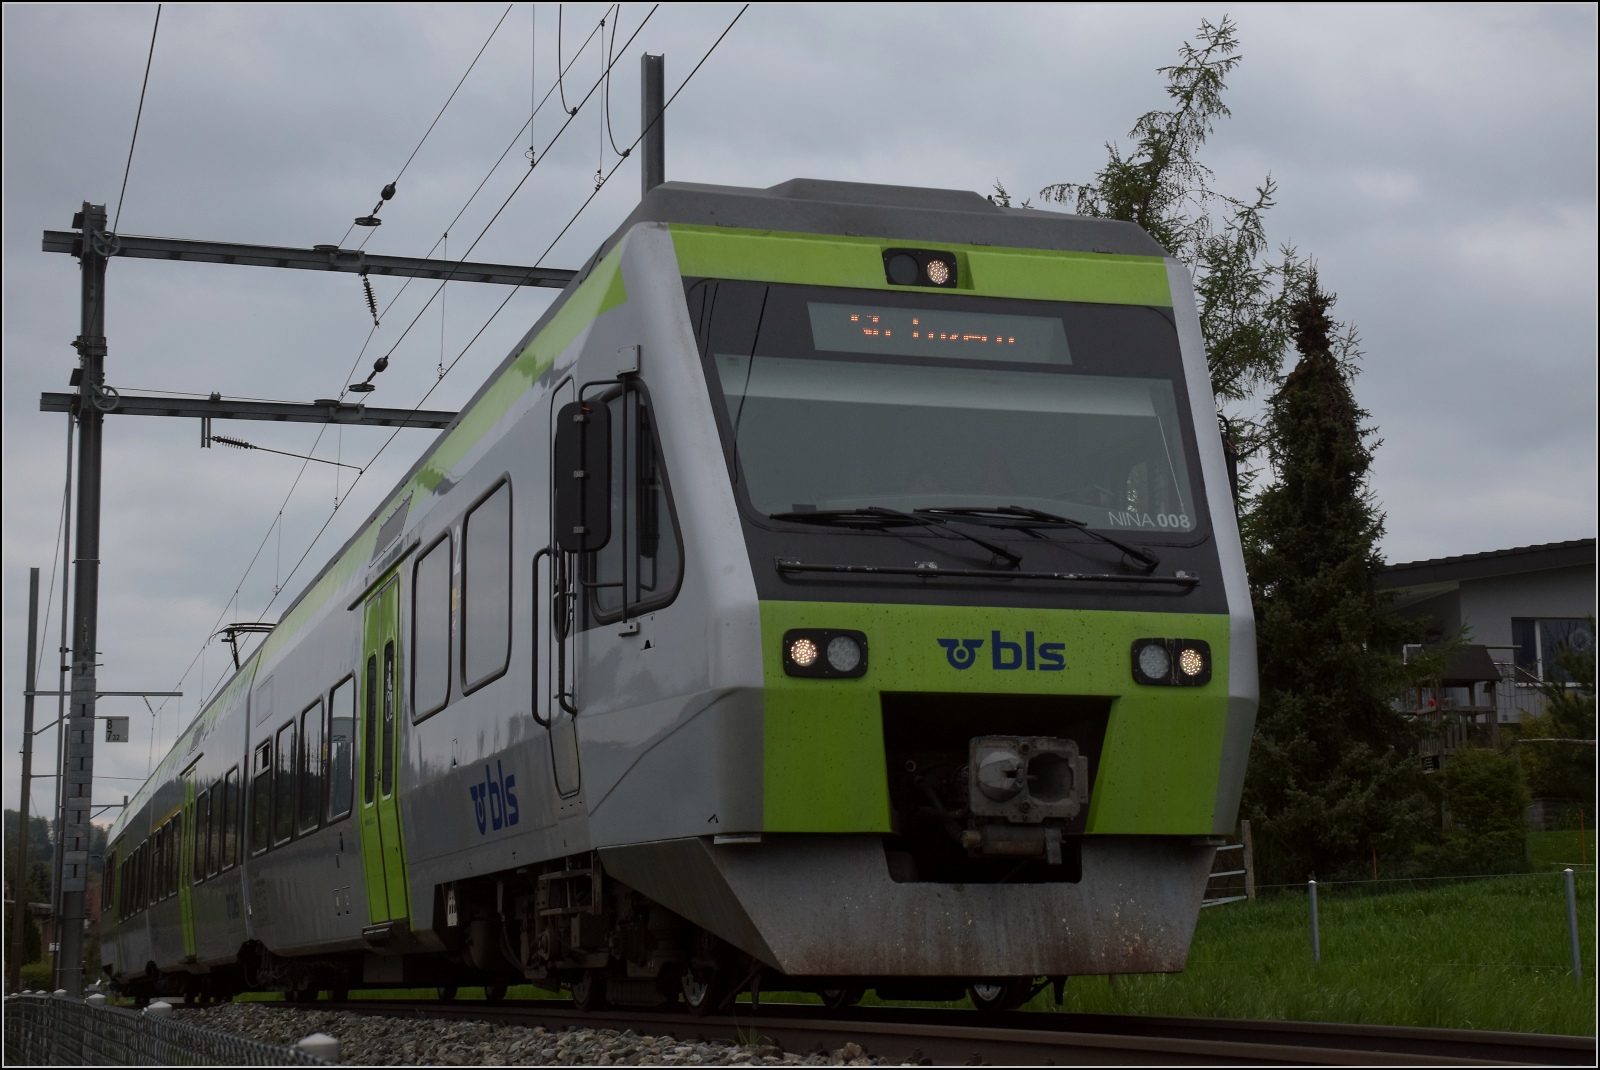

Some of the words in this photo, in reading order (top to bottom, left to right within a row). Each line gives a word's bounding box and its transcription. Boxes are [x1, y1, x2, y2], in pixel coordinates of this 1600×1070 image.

[1108, 511, 1155, 527] NINA
[1157, 513, 1191, 529] 008
[453, 524, 461, 576] 2
[991, 630, 1066, 671] bls
[107, 719, 112, 730] 8
[107, 730, 112, 741] 7
[485, 759, 519, 831] bls
